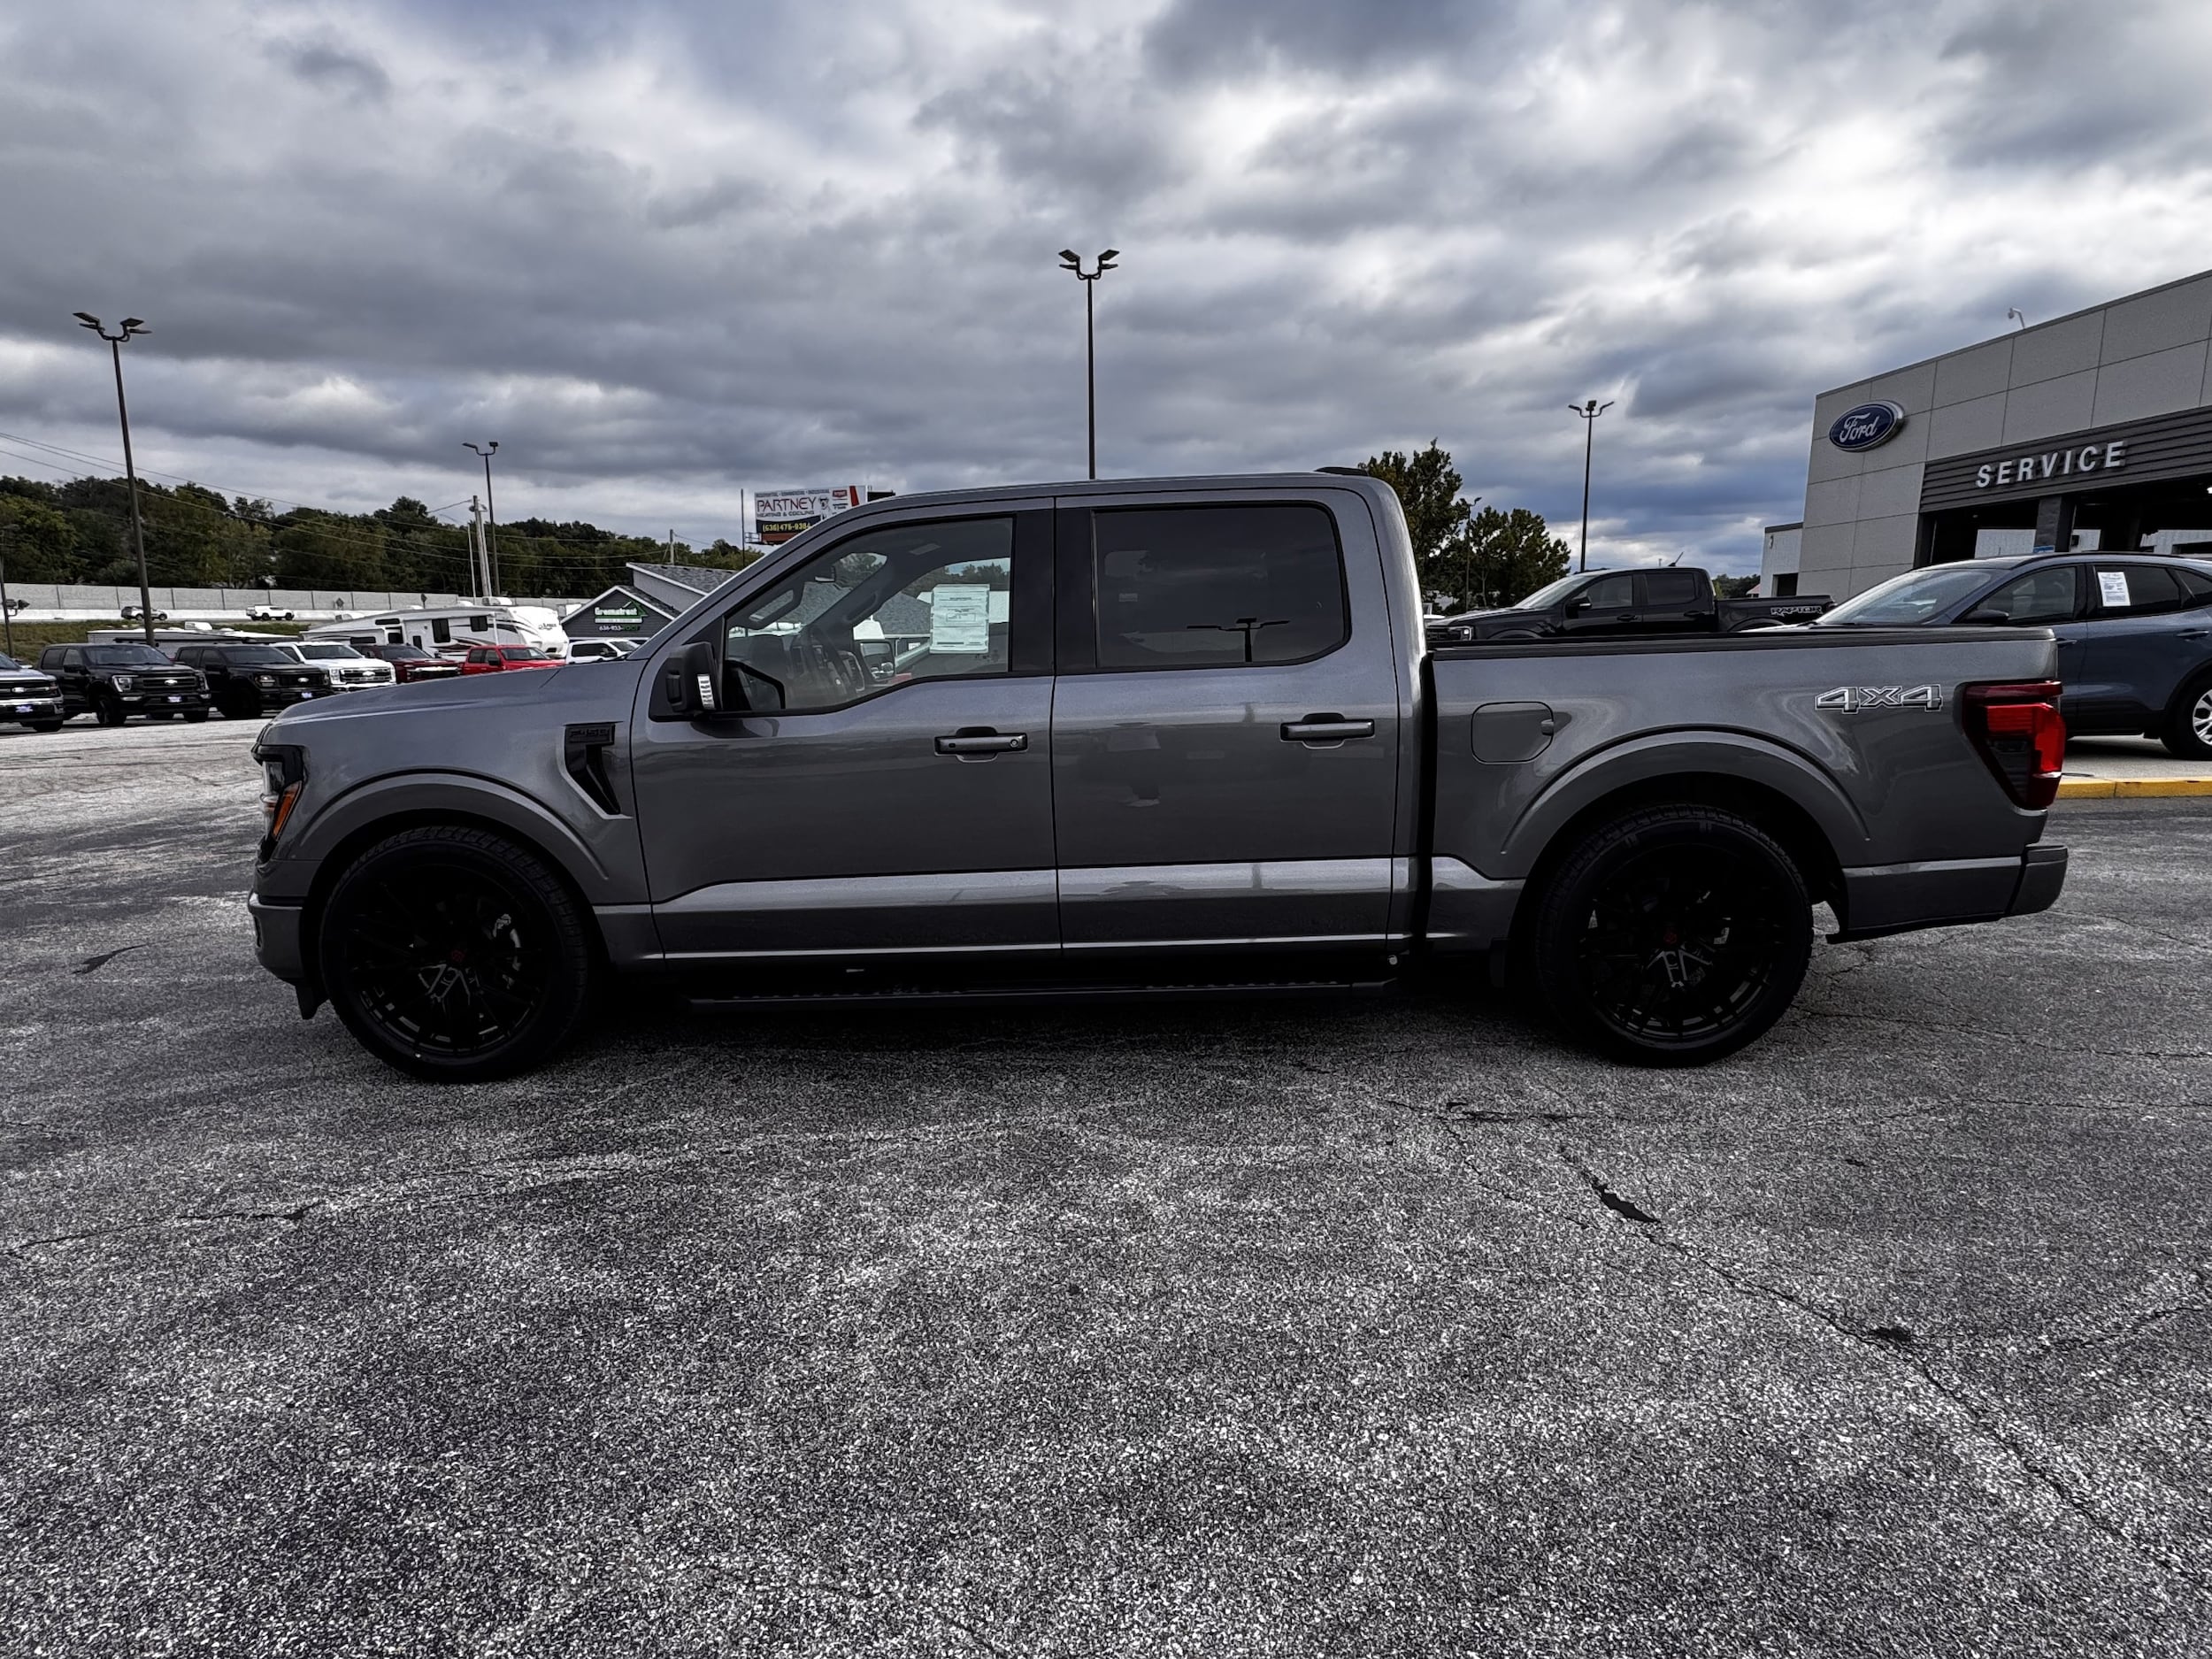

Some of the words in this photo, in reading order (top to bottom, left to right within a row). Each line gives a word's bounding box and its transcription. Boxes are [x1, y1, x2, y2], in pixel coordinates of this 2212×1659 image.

[1839, 411, 1878, 443] Ford
[1975, 441, 2125, 488] SERVICE
[757, 496, 817, 512] PARTNEY
[1770, 605, 1824, 618] RAPTOR
